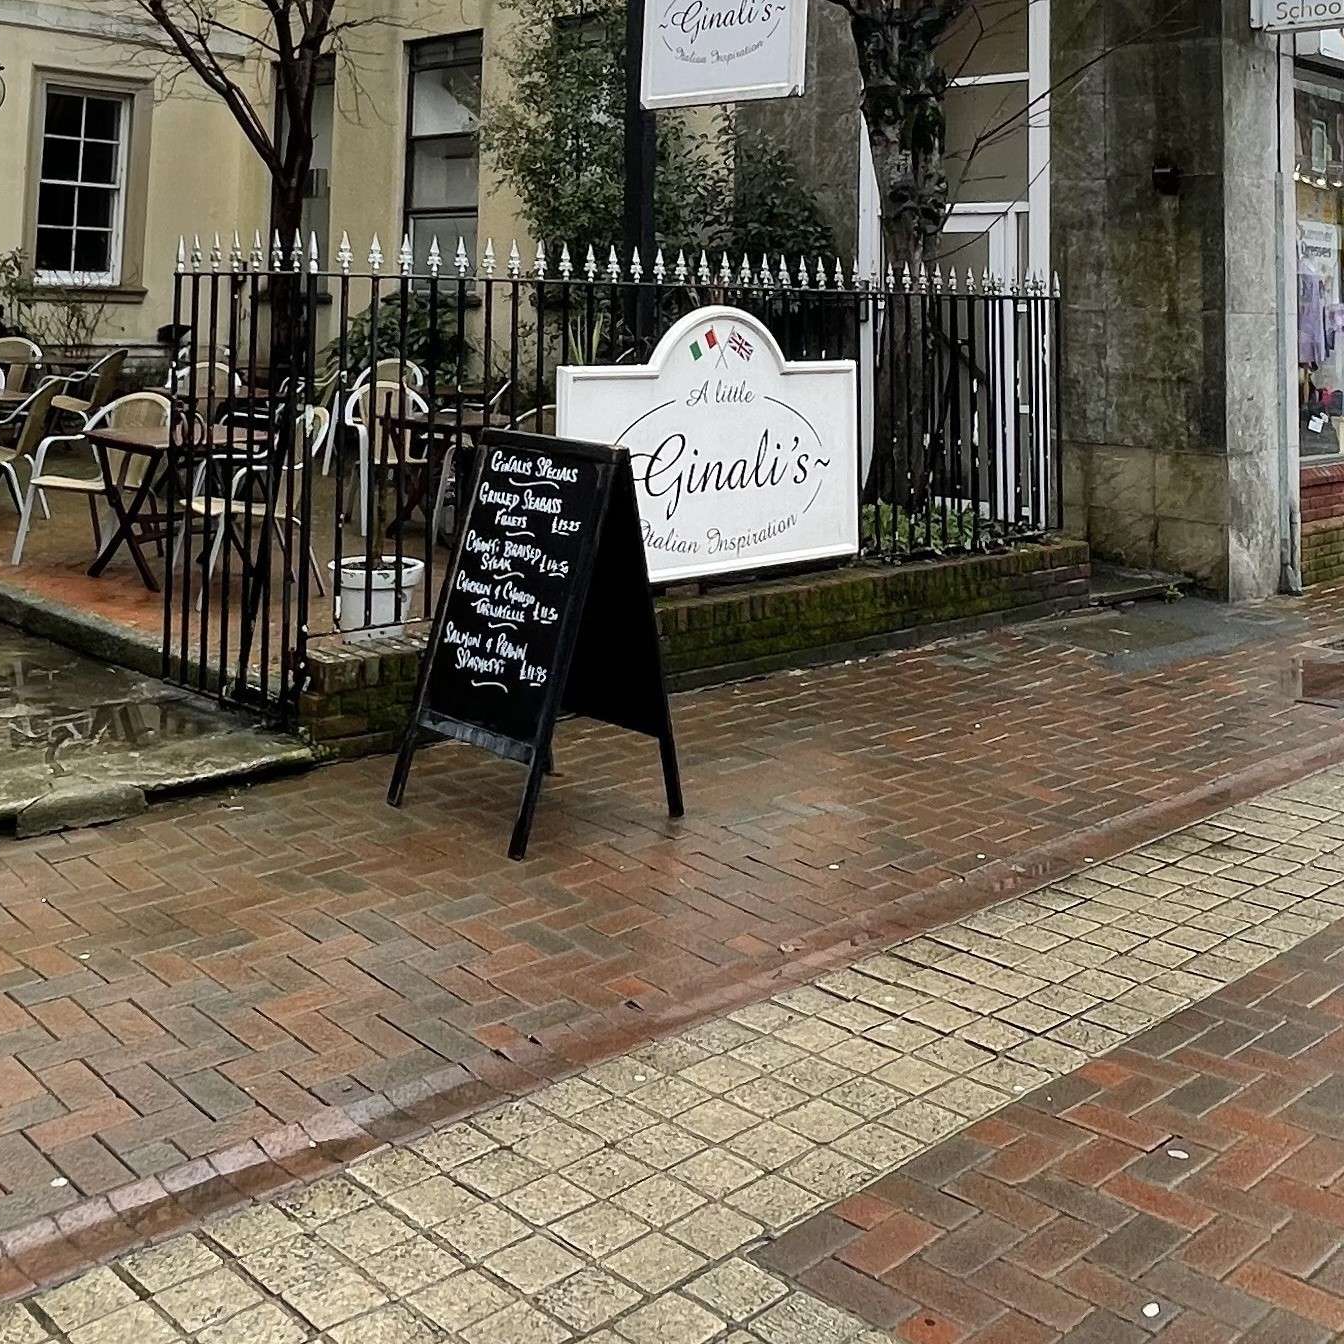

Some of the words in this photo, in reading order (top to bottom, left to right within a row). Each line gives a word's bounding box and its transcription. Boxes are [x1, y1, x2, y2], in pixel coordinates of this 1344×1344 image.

[686, 380, 709, 407] A
[715, 380, 755, 404] little
[535, 457, 579, 483] SPECIALS
[630, 428, 809, 521] Ginali's
[479, 481, 520, 512] GRILLED
[521, 489, 563, 514] SEABASS
[707, 514, 798, 555] Inspiration
[480, 553, 512, 572] STEAK
[503, 540, 542, 566] BRAISED
[443, 620, 482, 649] SALMON
[496, 632, 529, 661] PRAWN
